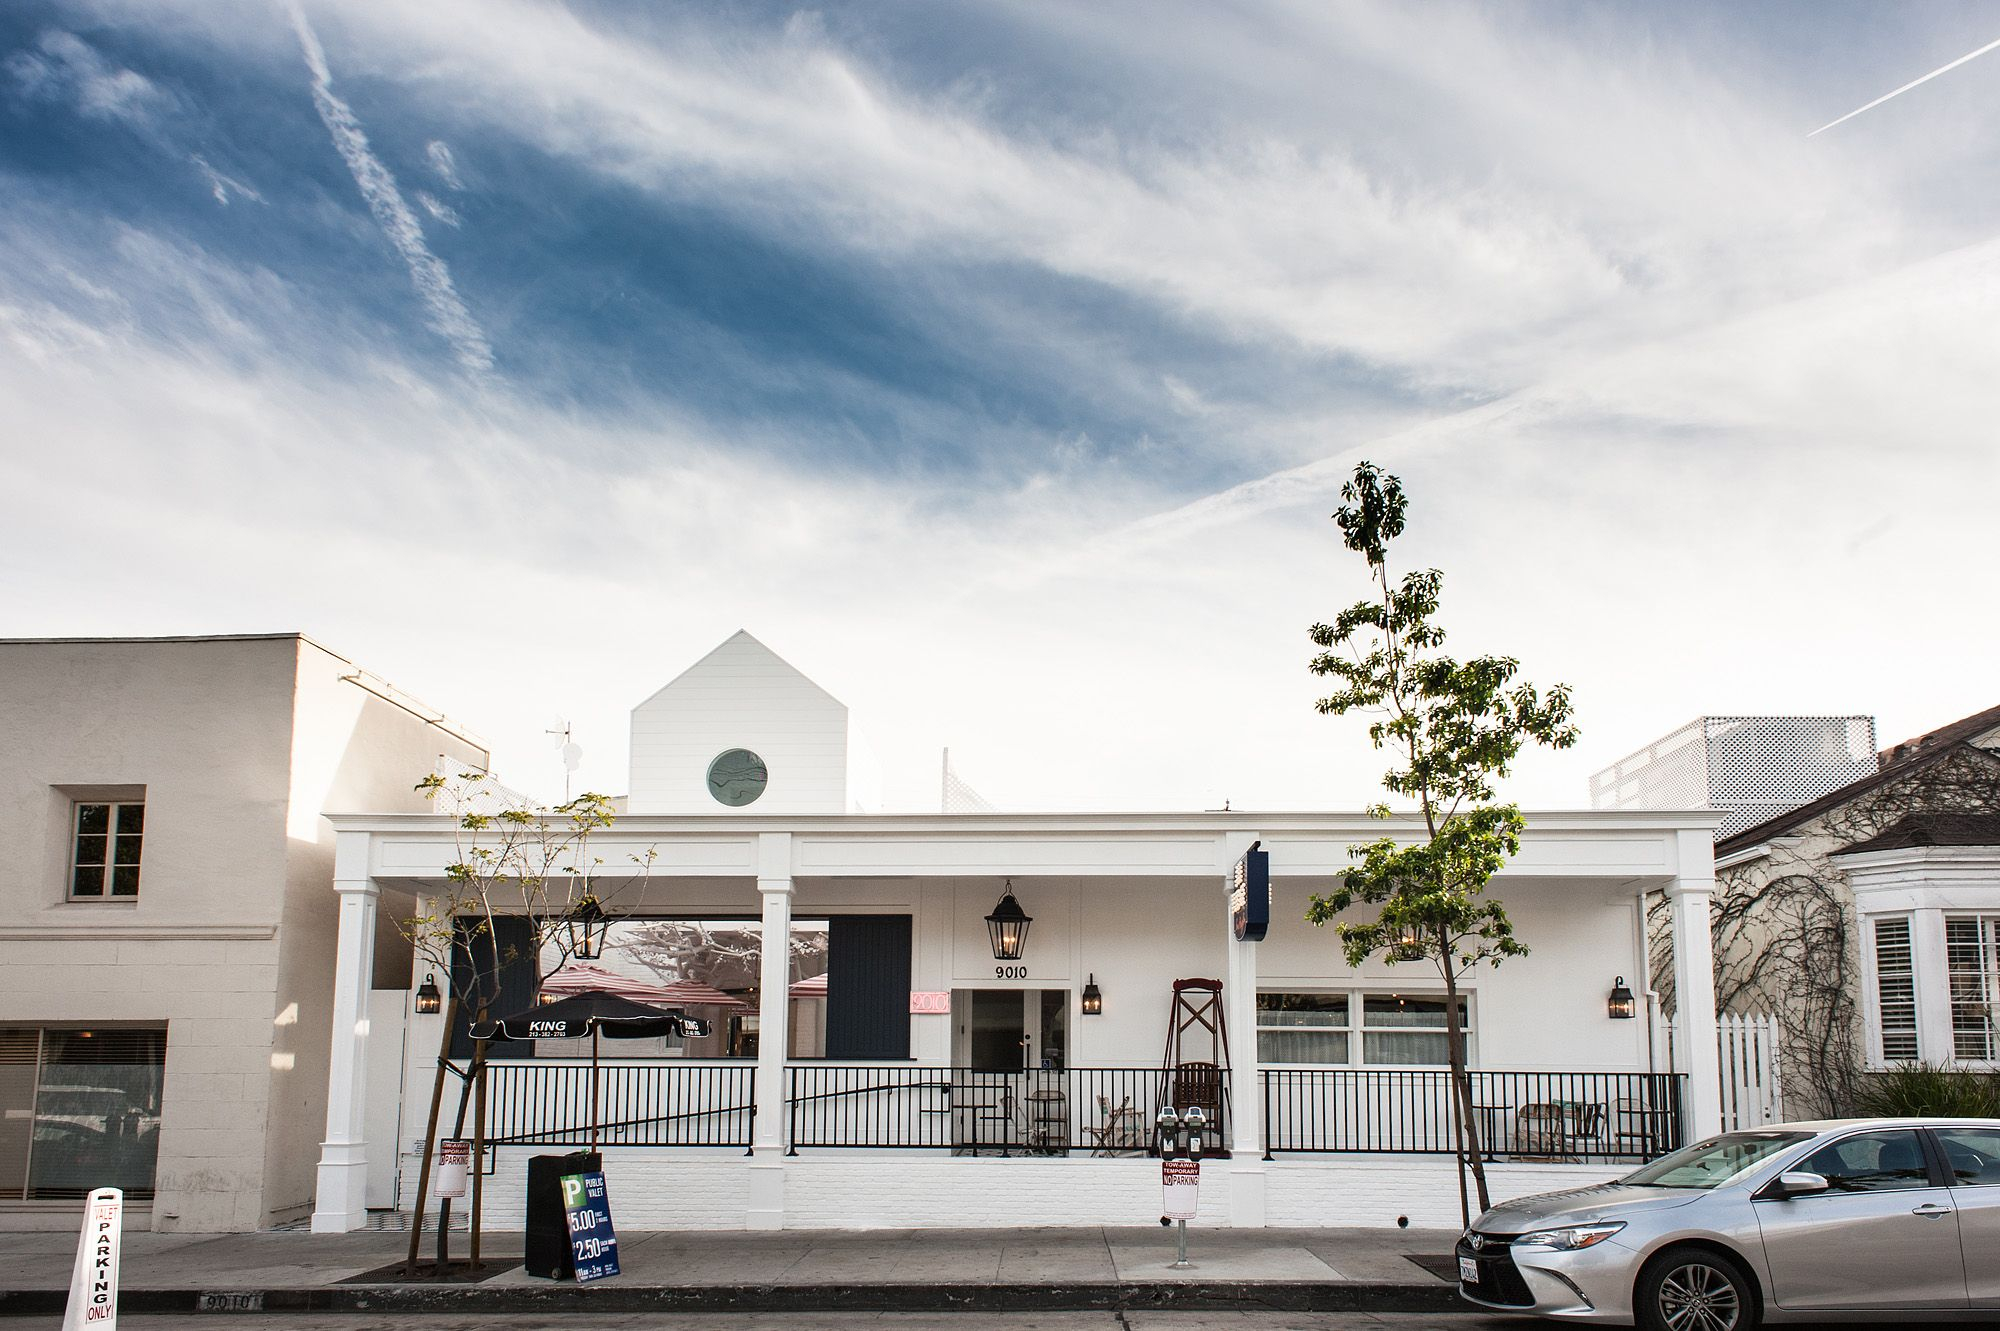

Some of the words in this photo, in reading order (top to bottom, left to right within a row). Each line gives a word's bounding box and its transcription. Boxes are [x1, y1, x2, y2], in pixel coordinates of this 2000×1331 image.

[995, 966, 1027, 978] 9010
[912, 995, 946, 1010] 9010
[529, 1021, 566, 1031] KING
[445, 1155, 469, 1165] PARKING
[585, 1178, 604, 1188] PUBLIC
[1164, 1175, 1172, 1185] NO
[1173, 1176, 1198, 1185] PARKING
[565, 1179, 581, 1205] P
[588, 1187, 603, 1197] VALET
[95, 1207, 118, 1220] VALET
[94, 1223, 110, 1304] PARKING
[207, 1294, 250, 1309] 9010
[88, 1305, 112, 1321] ONLY
